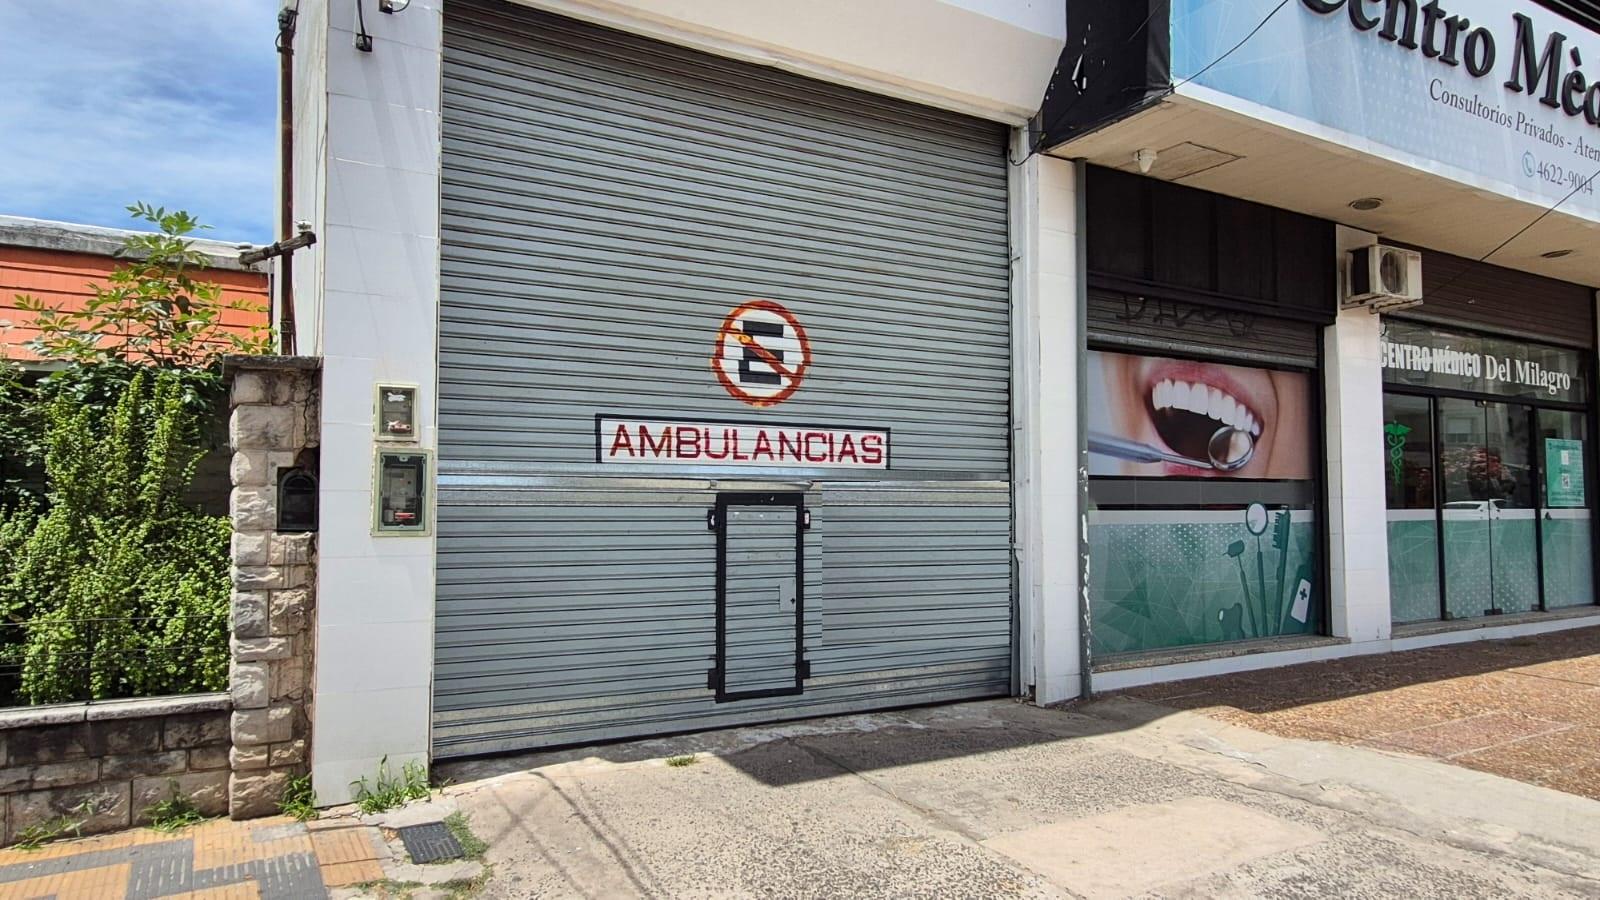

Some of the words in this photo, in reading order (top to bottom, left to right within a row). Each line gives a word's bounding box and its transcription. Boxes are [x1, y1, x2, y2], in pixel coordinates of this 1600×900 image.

[1299, 0, 1496, 78] entro
[1430, 78, 1513, 128] Consultorios
[1516, 111, 1565, 147] Privados
[1485, 354, 1511, 382] Del
[1515, 359, 1571, 395] Milagro
[610, 424, 883, 464] AMBULANCIAS
